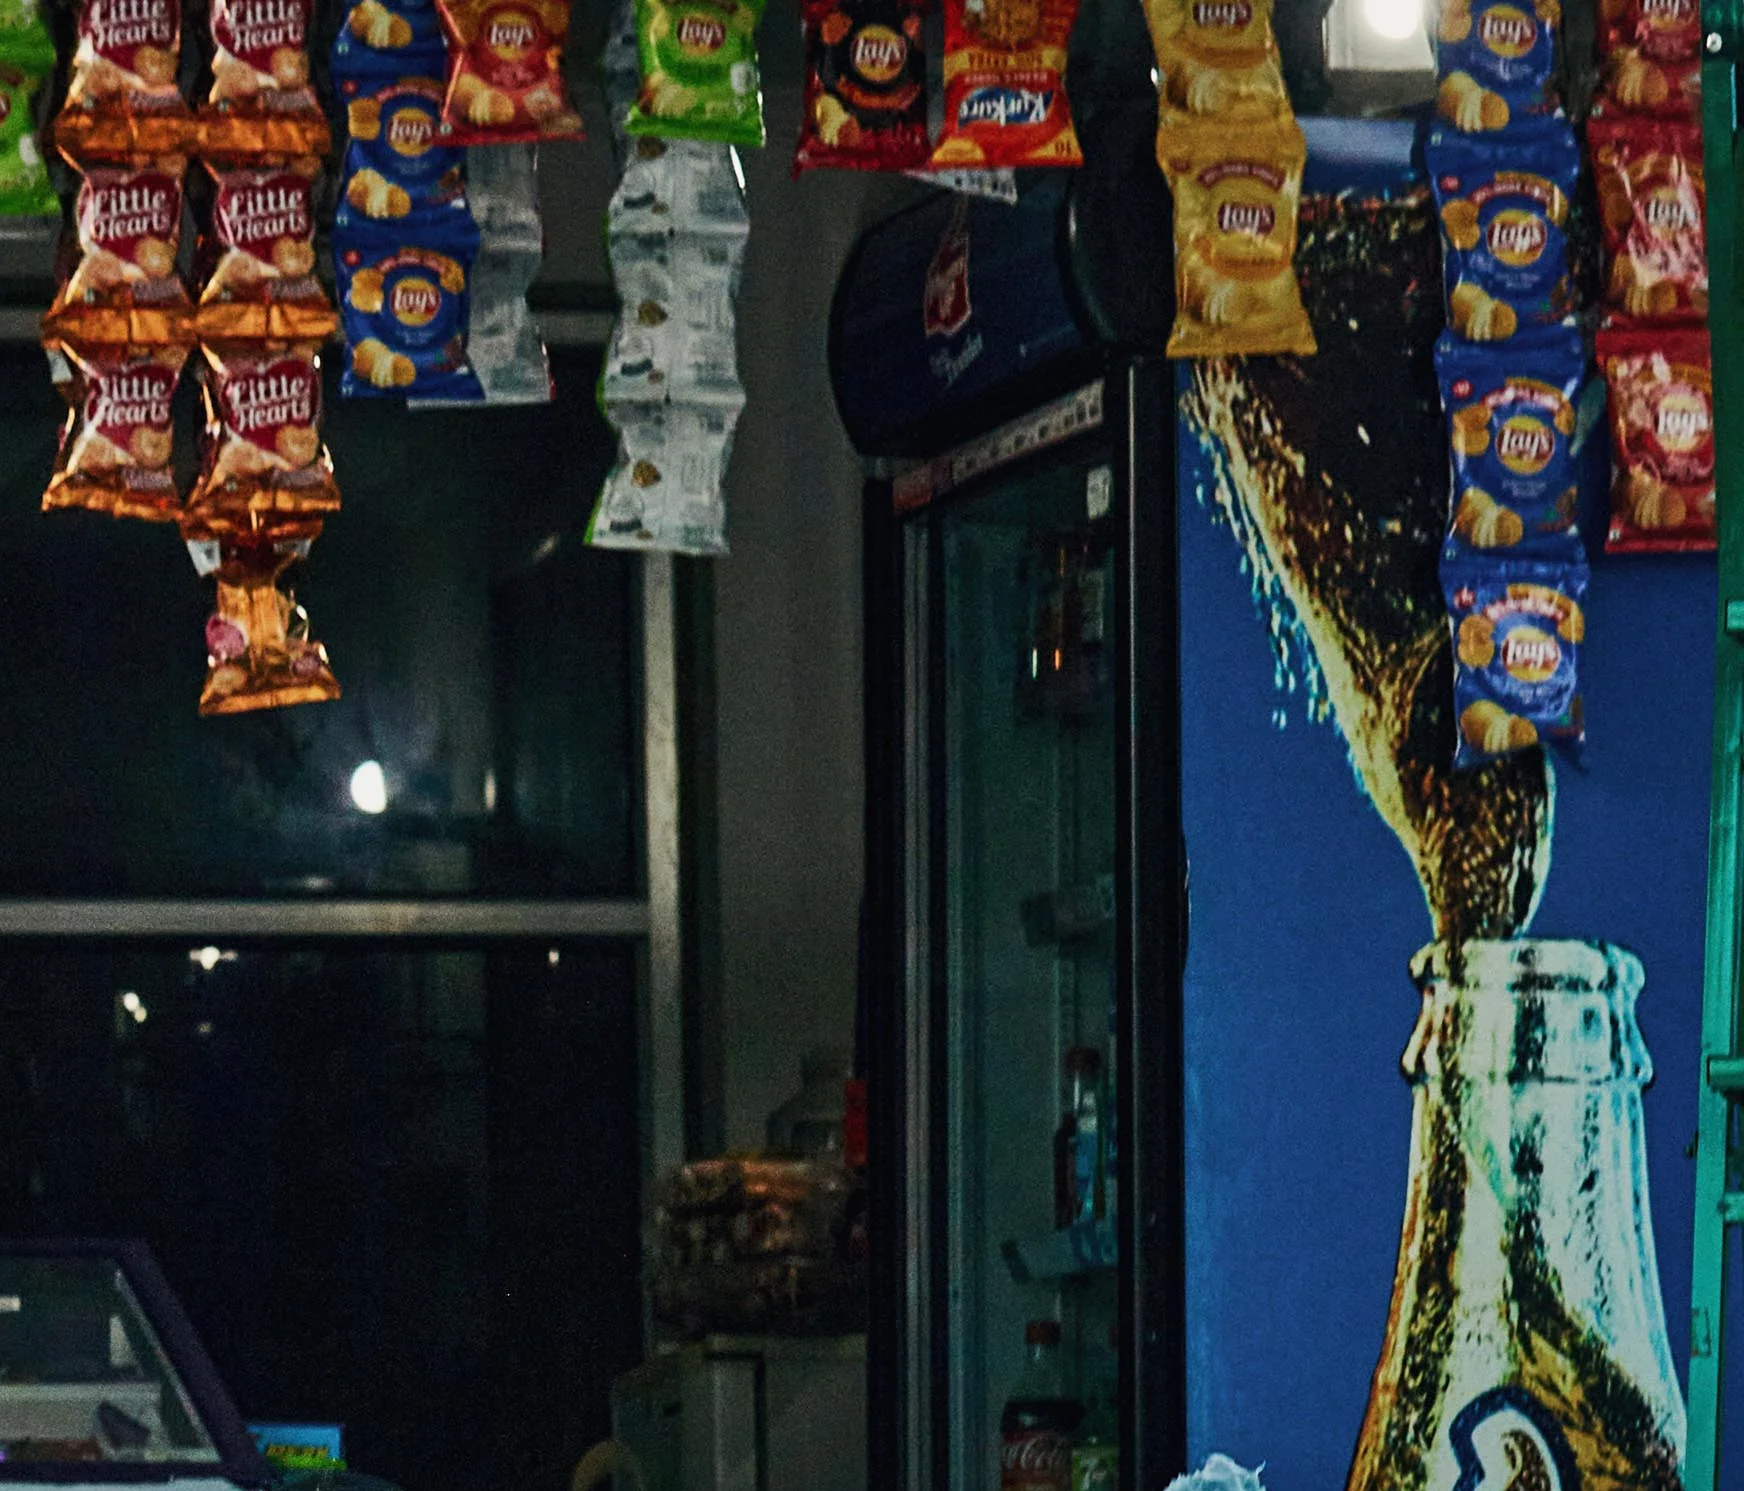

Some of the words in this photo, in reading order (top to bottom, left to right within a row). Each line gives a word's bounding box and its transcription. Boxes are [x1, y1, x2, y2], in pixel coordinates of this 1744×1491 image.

[98, 22, 170, 49] Hearts
[959, 88, 1050, 127] Kurkure
[94, 187, 167, 217] Little
[229, 188, 304, 219] Little
[92, 211, 170, 241] Hearts
[231, 214, 306, 242] Hearts
[229, 375, 305, 405] Little
[237, 400, 310, 431] Hearts
